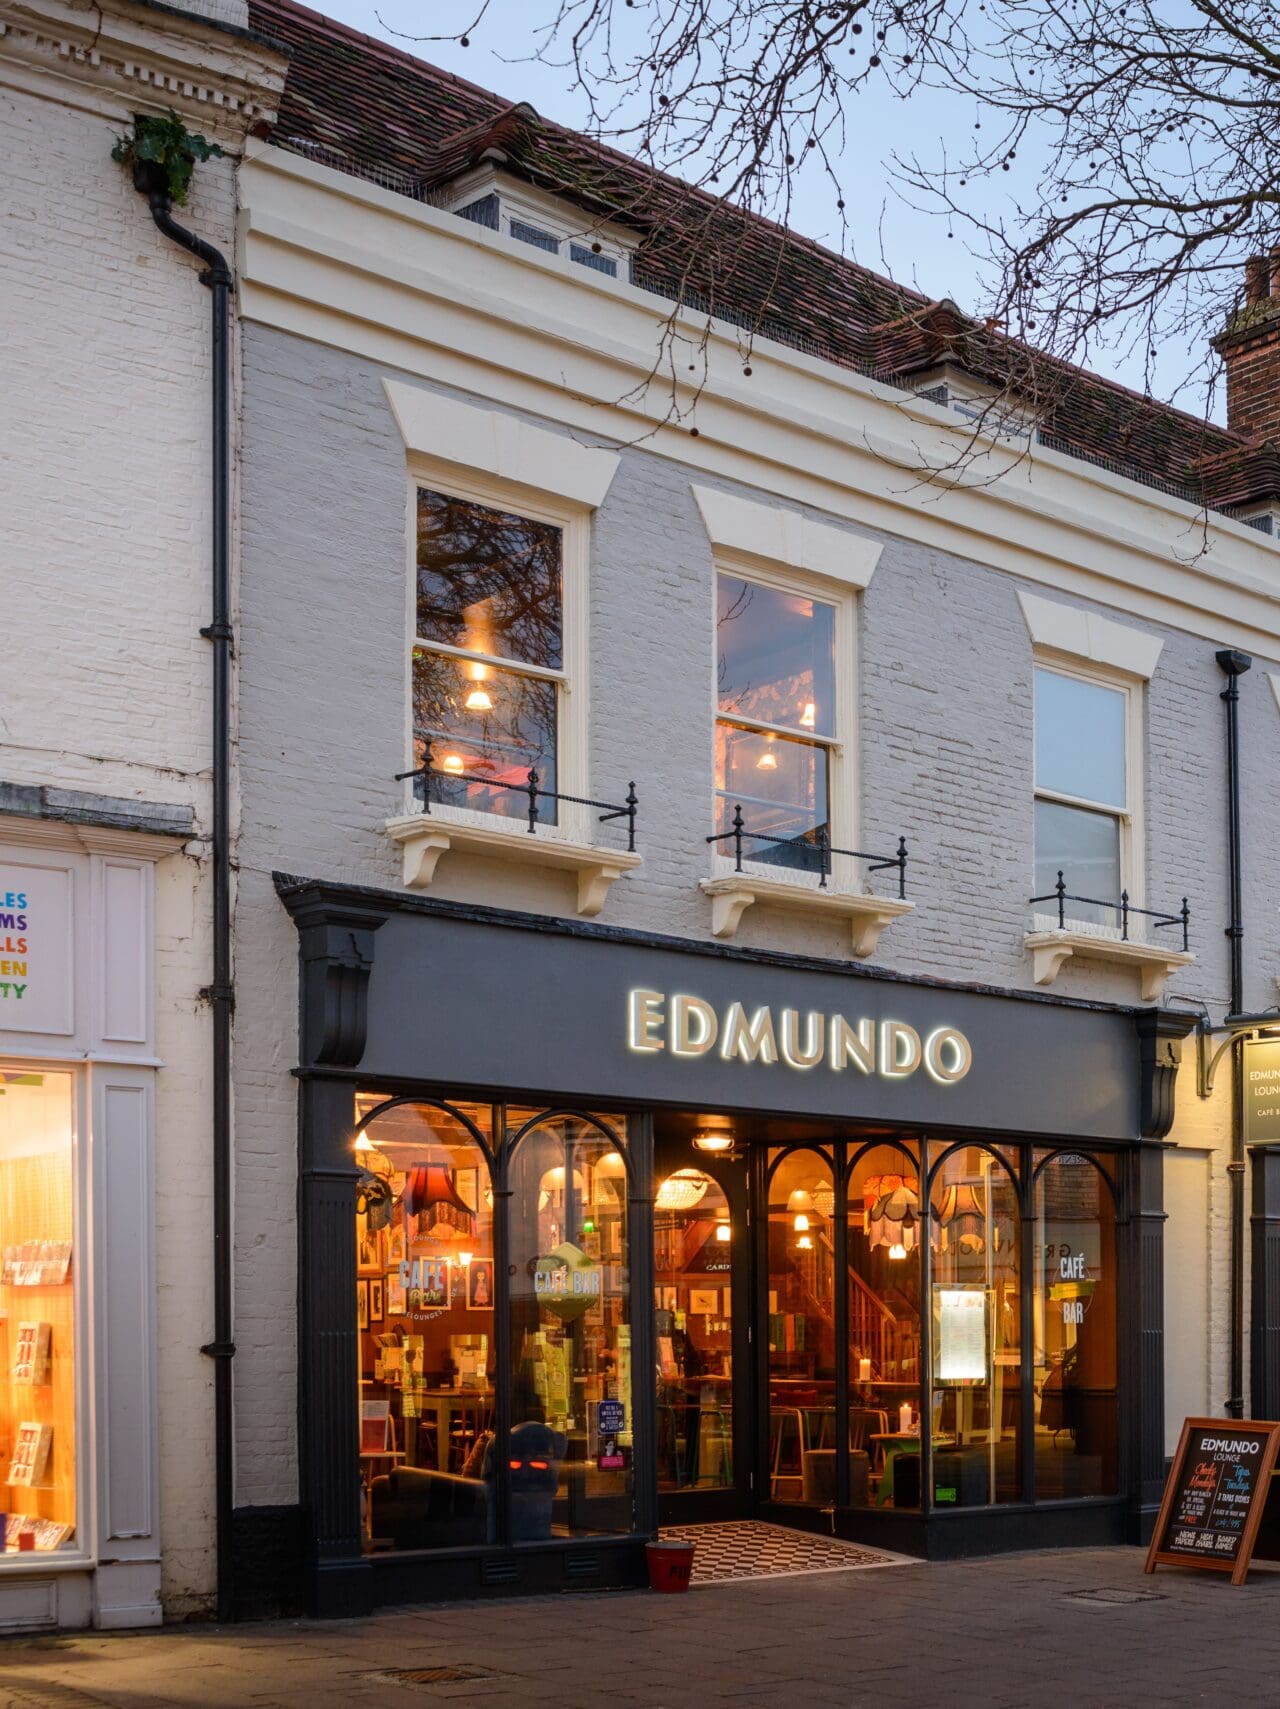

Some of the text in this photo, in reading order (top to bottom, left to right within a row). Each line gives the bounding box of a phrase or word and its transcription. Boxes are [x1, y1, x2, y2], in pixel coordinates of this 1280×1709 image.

[0, 892, 28, 909] ES
[627, 988, 973, 1083] EDMUNDO
[1257, 1107, 1273, 1117] CAFÉ
[1060, 1252, 1085, 1279] CAFÉ
[534, 1265, 600, 1294] CAFÉ BAR
[1063, 1302, 1084, 1324] BAR
[1201, 1438, 1259, 1454] EDMUNDO
[1213, 1452, 1241, 1463] LOUNGE
